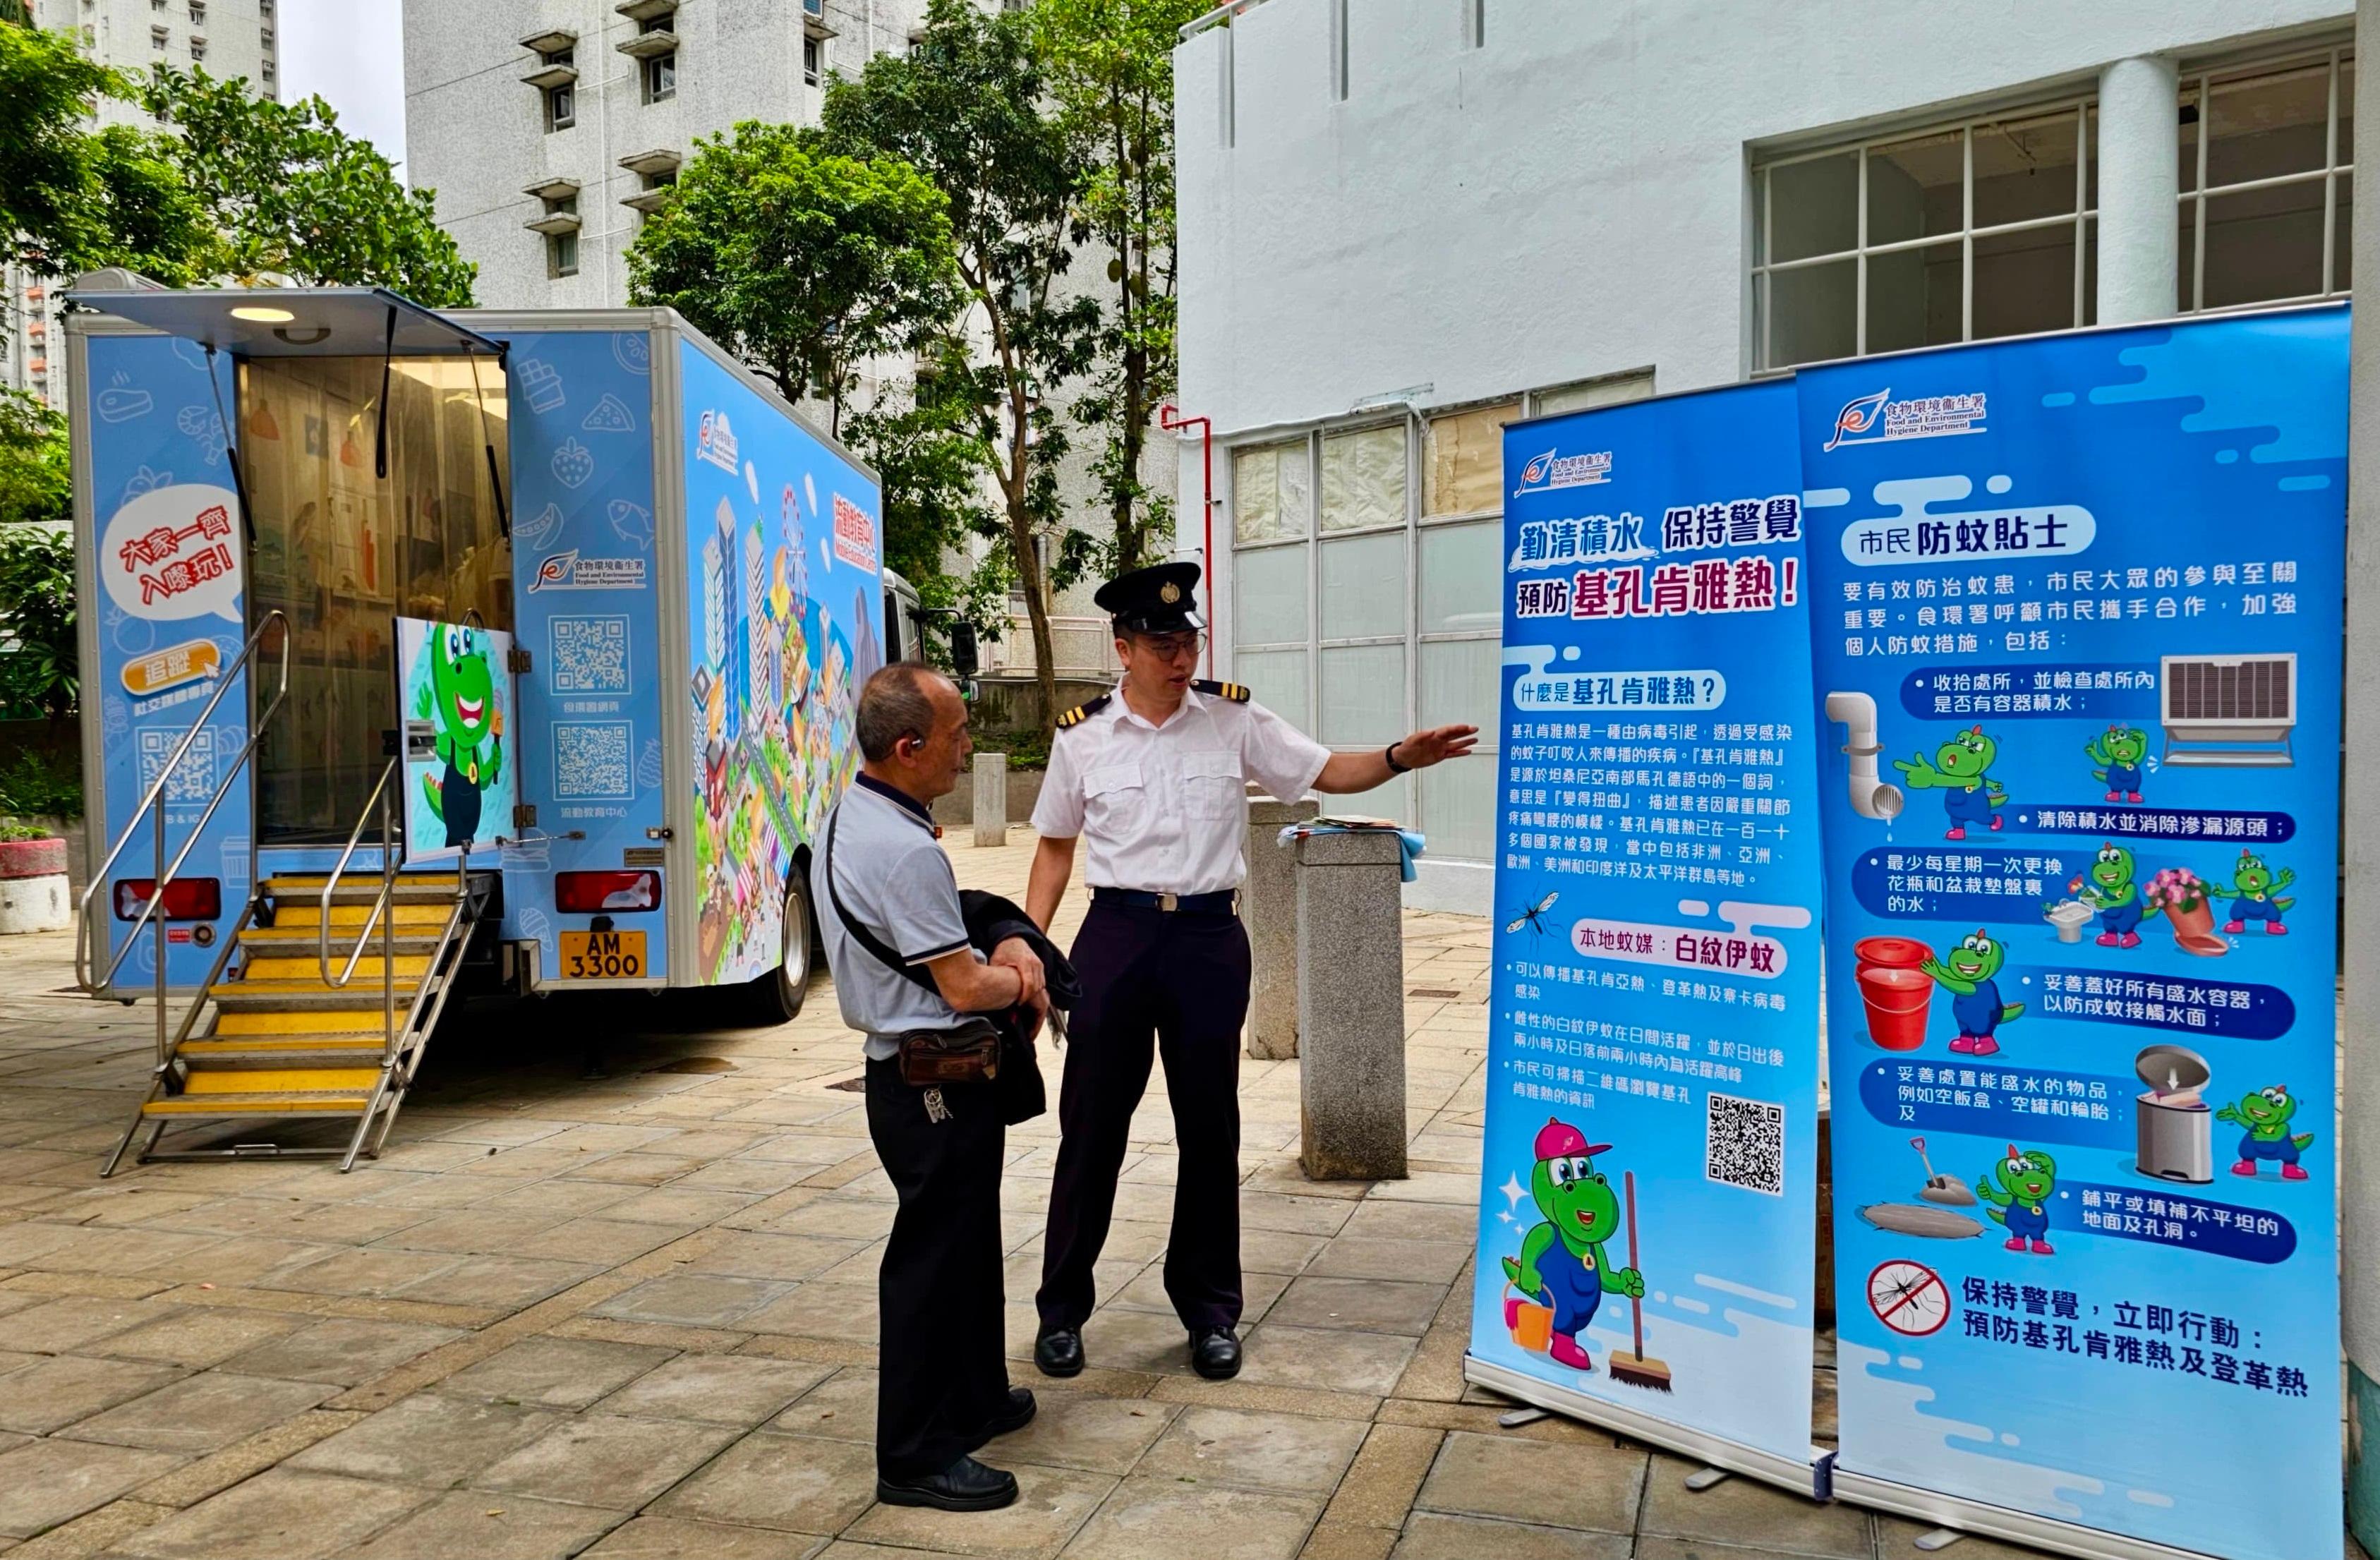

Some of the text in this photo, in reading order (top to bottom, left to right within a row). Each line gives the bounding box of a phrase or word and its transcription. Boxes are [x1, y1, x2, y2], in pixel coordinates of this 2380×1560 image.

[1887, 394, 1984, 417] 食物環境衛生署
[1925, 410, 1984, 423] Environmental
[1887, 422, 1968, 436] Hygiene Department
[1553, 453, 1611, 470] 食物環境衛生署
[1575, 466, 1609, 475] Environmental
[1571, 475, 1600, 483] Department
[120, 506, 231, 572] 大家一齊
[1521, 499, 1798, 561] 勤清積水 保持警覺
[1859, 514, 2070, 556] 市民防蚊貼士
[140, 543, 234, 605] 入嚟玩！
[576, 560, 644, 571] 食物環境衛生署
[145, 651, 191, 687] 追蹤
[176, 814, 185, 824] &
[188, 814, 200, 824] IG
[1887, 855, 2062, 875] 最少每星期一次更換
[586, 933, 620, 955] AM
[569, 955, 639, 977] 3300
[1515, 984, 1541, 1000] 感染
[1513, 1082, 1595, 1110] 肯雅熱的資訊
[1899, 1105, 1916, 1122] 及
[1964, 1310, 2309, 1398] 預防基孔肯雅熱及登革熱
